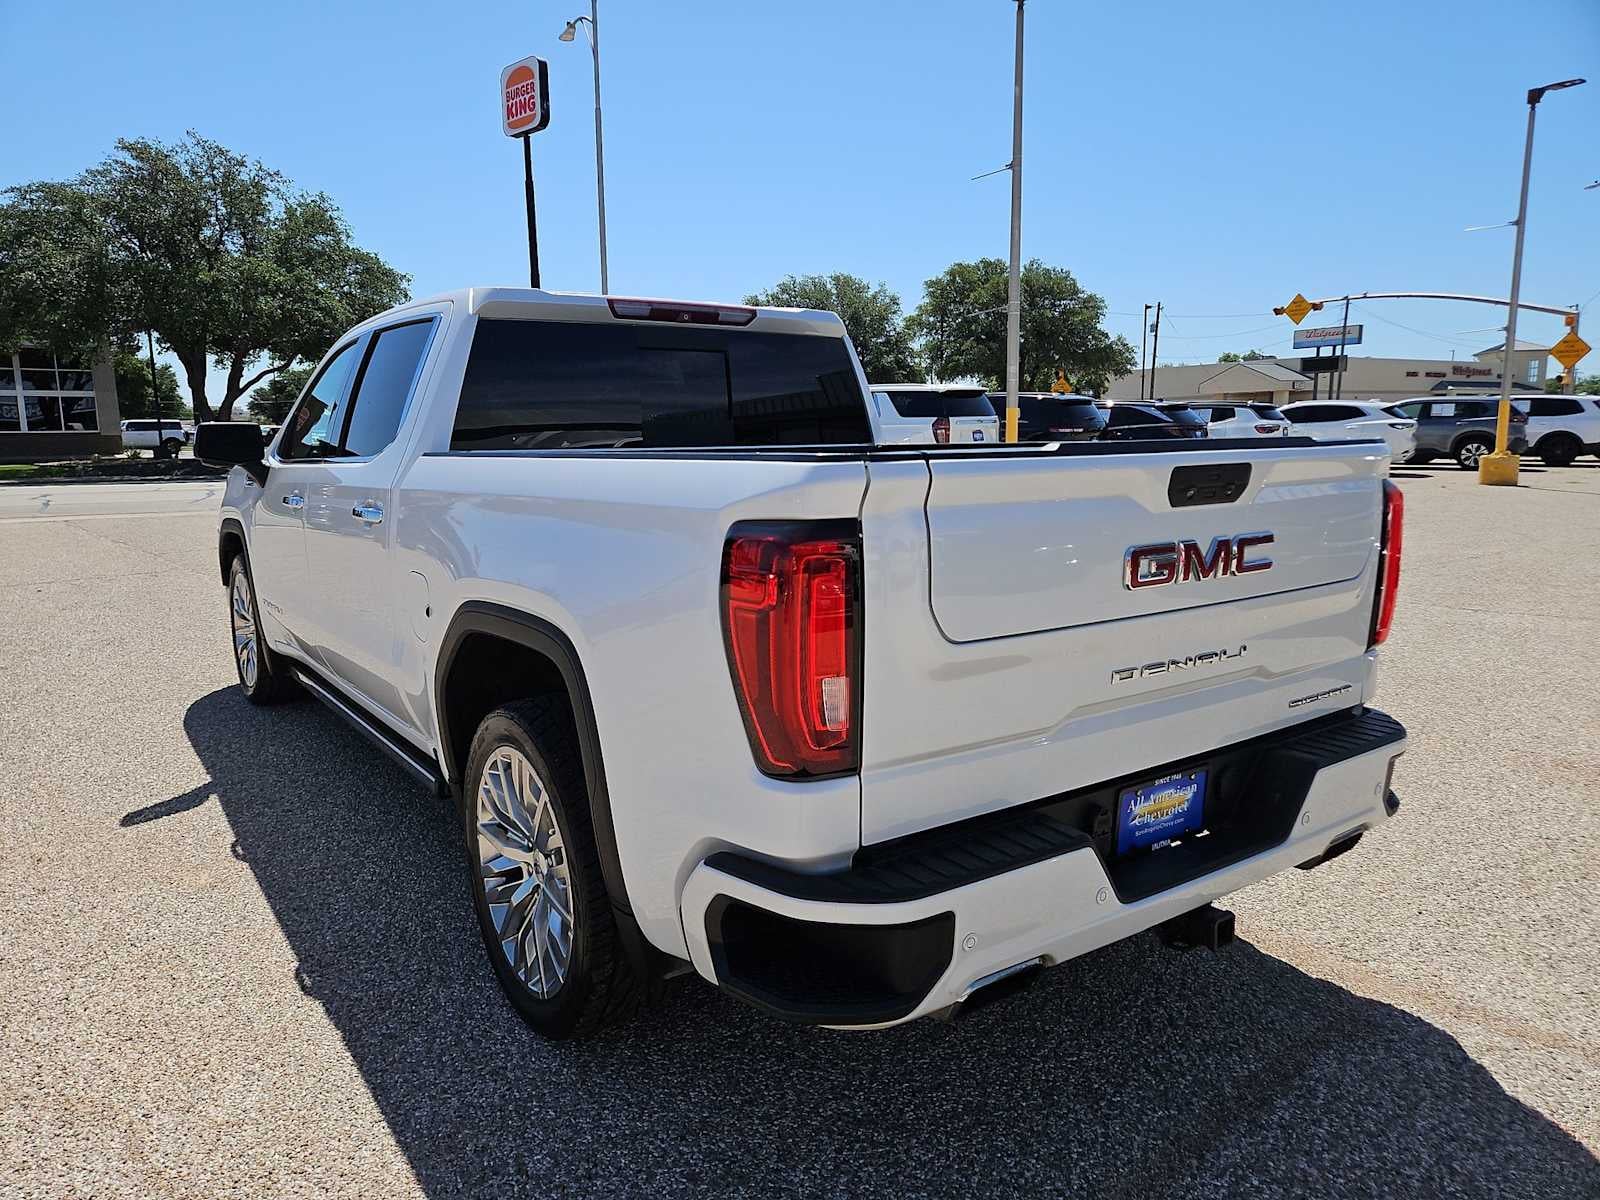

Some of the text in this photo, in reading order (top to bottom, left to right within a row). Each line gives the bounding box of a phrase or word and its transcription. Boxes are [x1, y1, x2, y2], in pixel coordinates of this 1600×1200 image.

[506, 81, 535, 103] BURGER
[507, 95, 536, 120] KING
[1123, 531, 1276, 591] GMC
[1111, 645, 1248, 685] DENALI
[1135, 802, 1188, 826] Chevrolet
